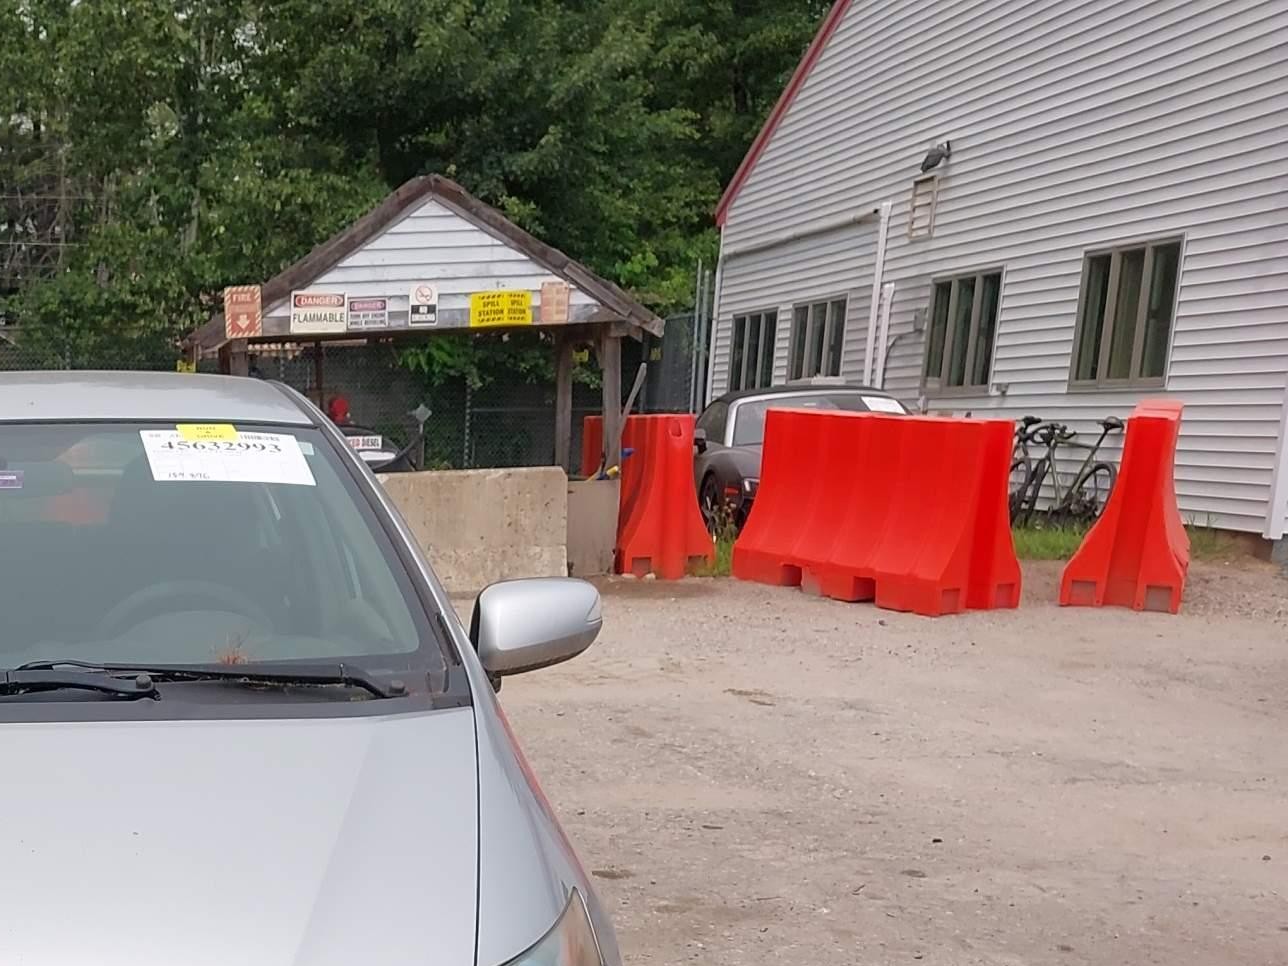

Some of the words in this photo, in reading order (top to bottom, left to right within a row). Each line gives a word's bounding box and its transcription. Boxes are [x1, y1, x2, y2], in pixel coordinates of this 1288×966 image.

[300, 295, 338, 305] DANGER
[293, 311, 345, 323] FLAMMABLE
[478, 309, 504, 317] STATION
[161, 441, 282, 453] 45632993
